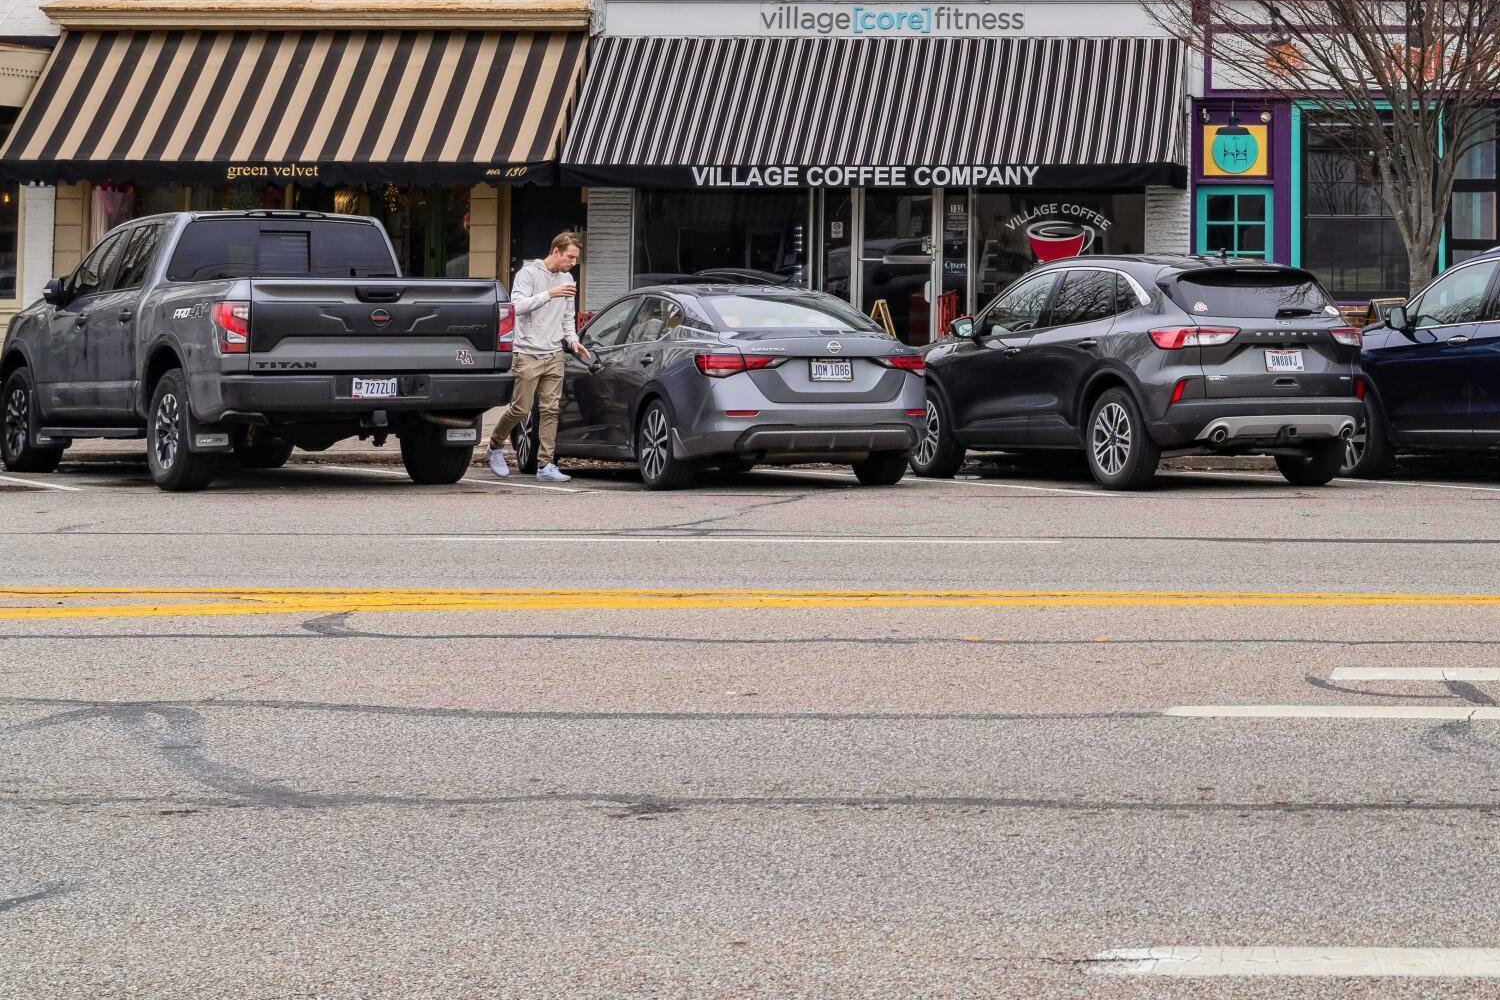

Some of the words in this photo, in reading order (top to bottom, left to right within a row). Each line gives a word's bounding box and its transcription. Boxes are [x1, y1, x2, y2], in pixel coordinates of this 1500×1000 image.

[226, 165, 269, 180] green
[272, 163, 320, 177] velvet
[505, 166, 528, 177] 130
[692, 166, 798, 187] VILLAGE
[806, 166, 906, 187] COFFEE
[913, 166, 1040, 187] COMPANY
[1005, 203, 1058, 231] VILLAGE
[1061, 203, 1112, 232] COFFEE
[256, 361, 317, 369] TITAN
[830, 364, 850, 376] 1086
